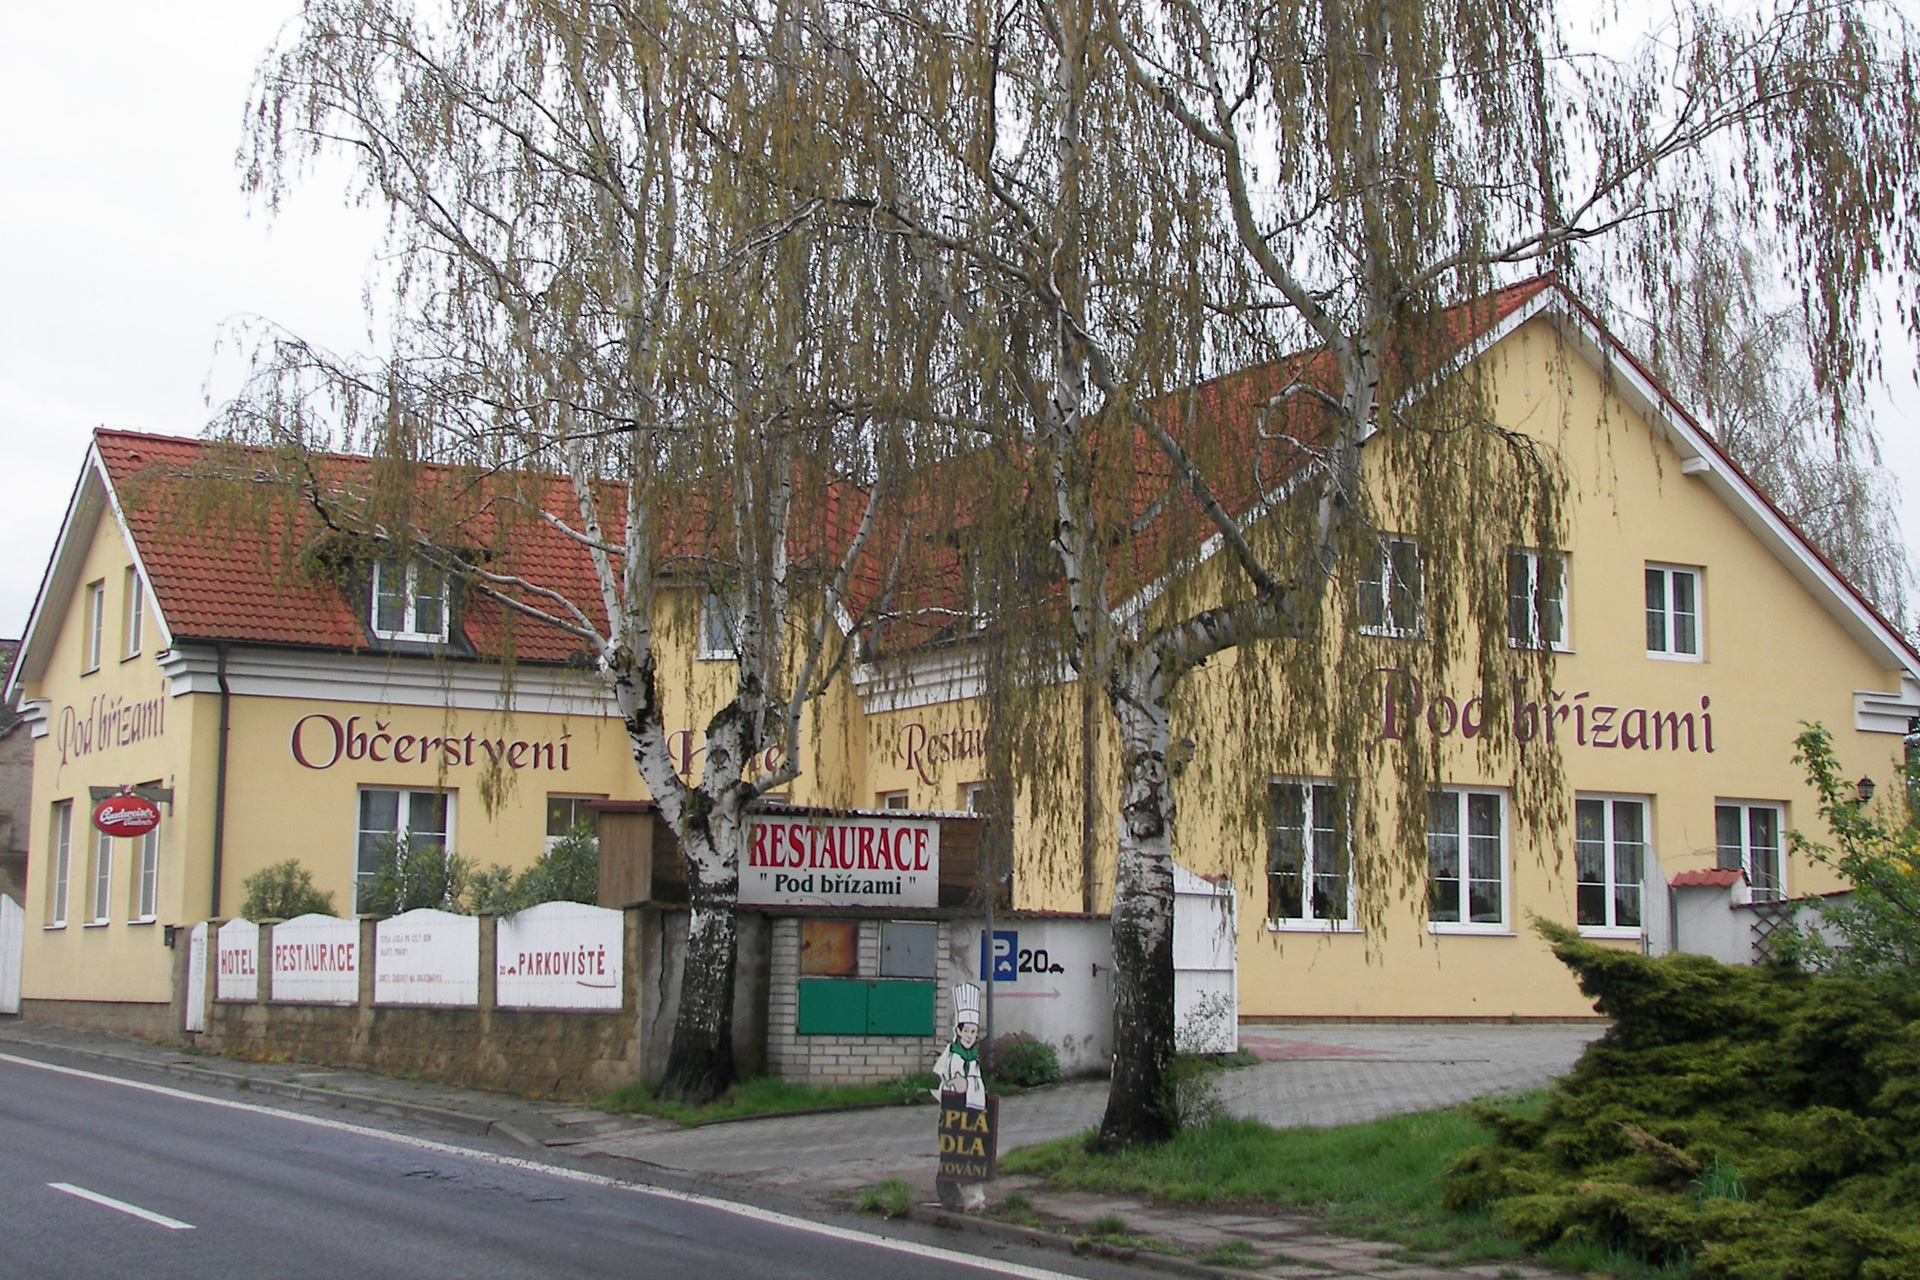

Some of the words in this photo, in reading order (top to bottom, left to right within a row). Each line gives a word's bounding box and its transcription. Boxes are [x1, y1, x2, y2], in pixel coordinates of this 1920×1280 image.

[57, 695, 97, 790] Pod
[749, 823, 931, 871] RESTAURACE
[774, 873, 813, 893] Pod
[821, 874, 902, 895] břízami
[221, 949, 256, 975] HOTEL
[275, 943, 355, 972] RESTAURACE
[519, 944, 605, 975] PARKOVIŠTĚ
[1018, 949, 1049, 973] 20
